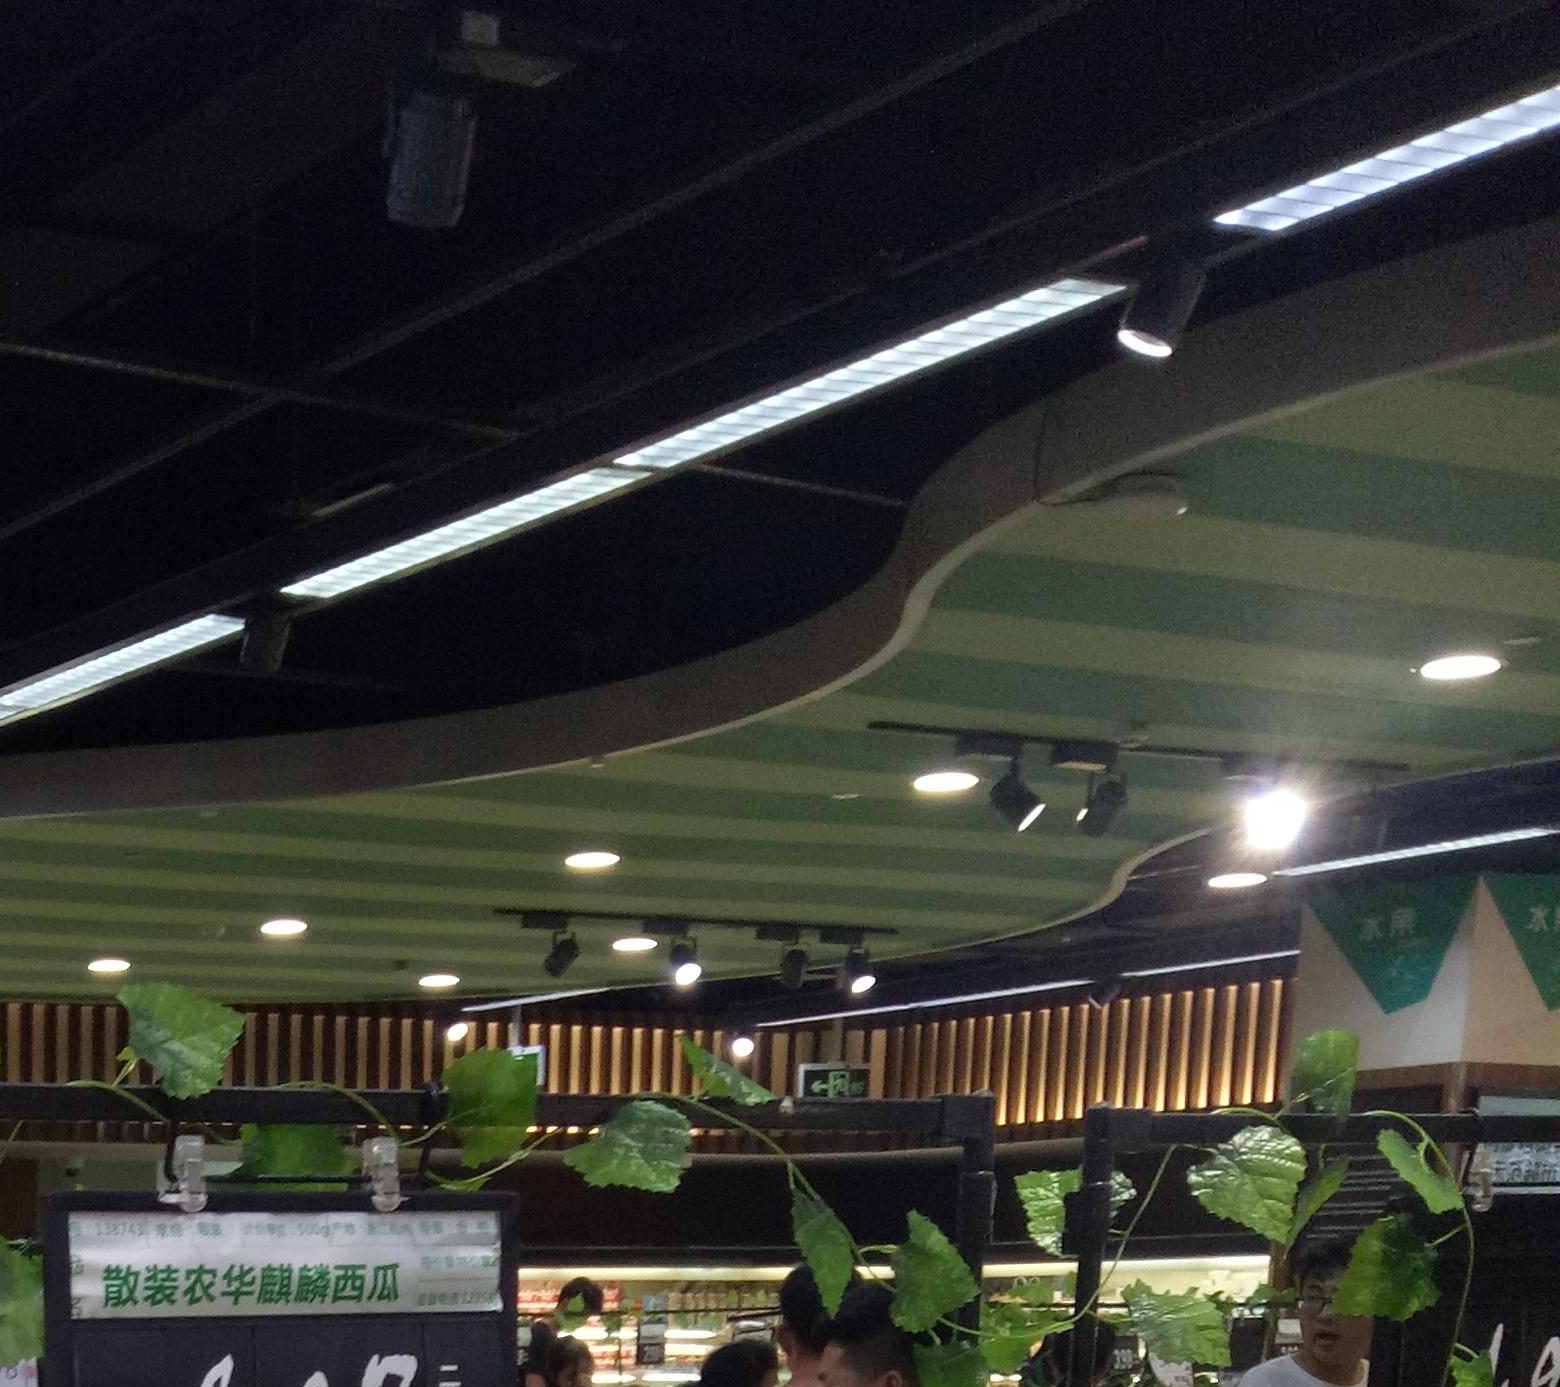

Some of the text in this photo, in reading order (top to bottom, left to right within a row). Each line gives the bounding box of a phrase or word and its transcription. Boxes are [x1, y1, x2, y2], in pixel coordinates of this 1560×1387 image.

[102, 1262, 401, 1308] 散装农华麒麟西瓜
